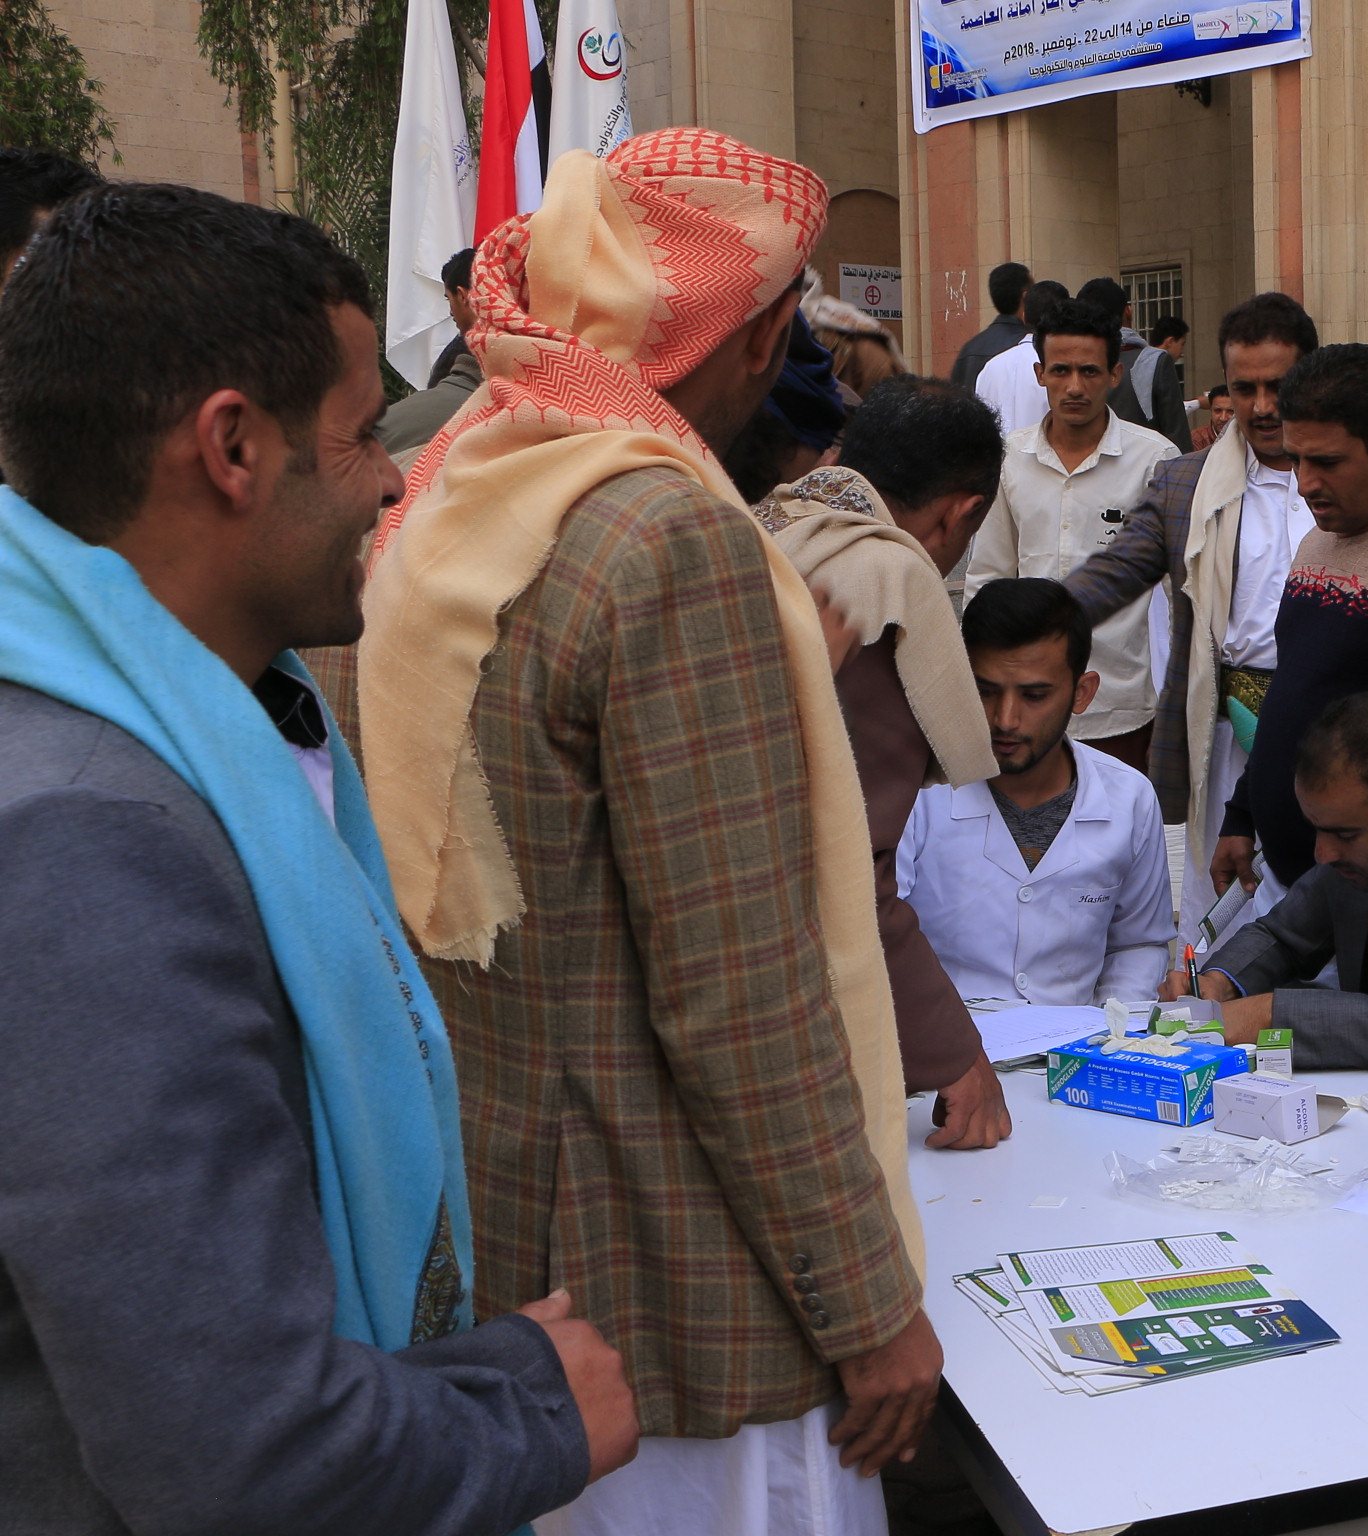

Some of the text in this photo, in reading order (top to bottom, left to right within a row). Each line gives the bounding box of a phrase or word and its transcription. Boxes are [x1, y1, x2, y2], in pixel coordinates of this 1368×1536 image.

[960, 6, 1003, 30] العاصمة
[1157, 12, 1191, 30] صنعاء
[1084, 28, 1098, 43] 22
[1120, 20, 1132, 36] 14
[1136, 18, 1153, 37] من
[1027, 42, 1163, 77] مستشفى جامعة العلوم والتكنولوجيا
[879, 309, 890, 318] THIS
[1113, 1053, 1190, 1071] BEROGLOVE
[1051, 1062, 1081, 1094] BEROGLOVE
[1065, 1087, 1089, 1105] 100
[1190, 1069, 1217, 1117] BEROGLOVE
[1300, 1098, 1309, 1136] ALCOHOL
